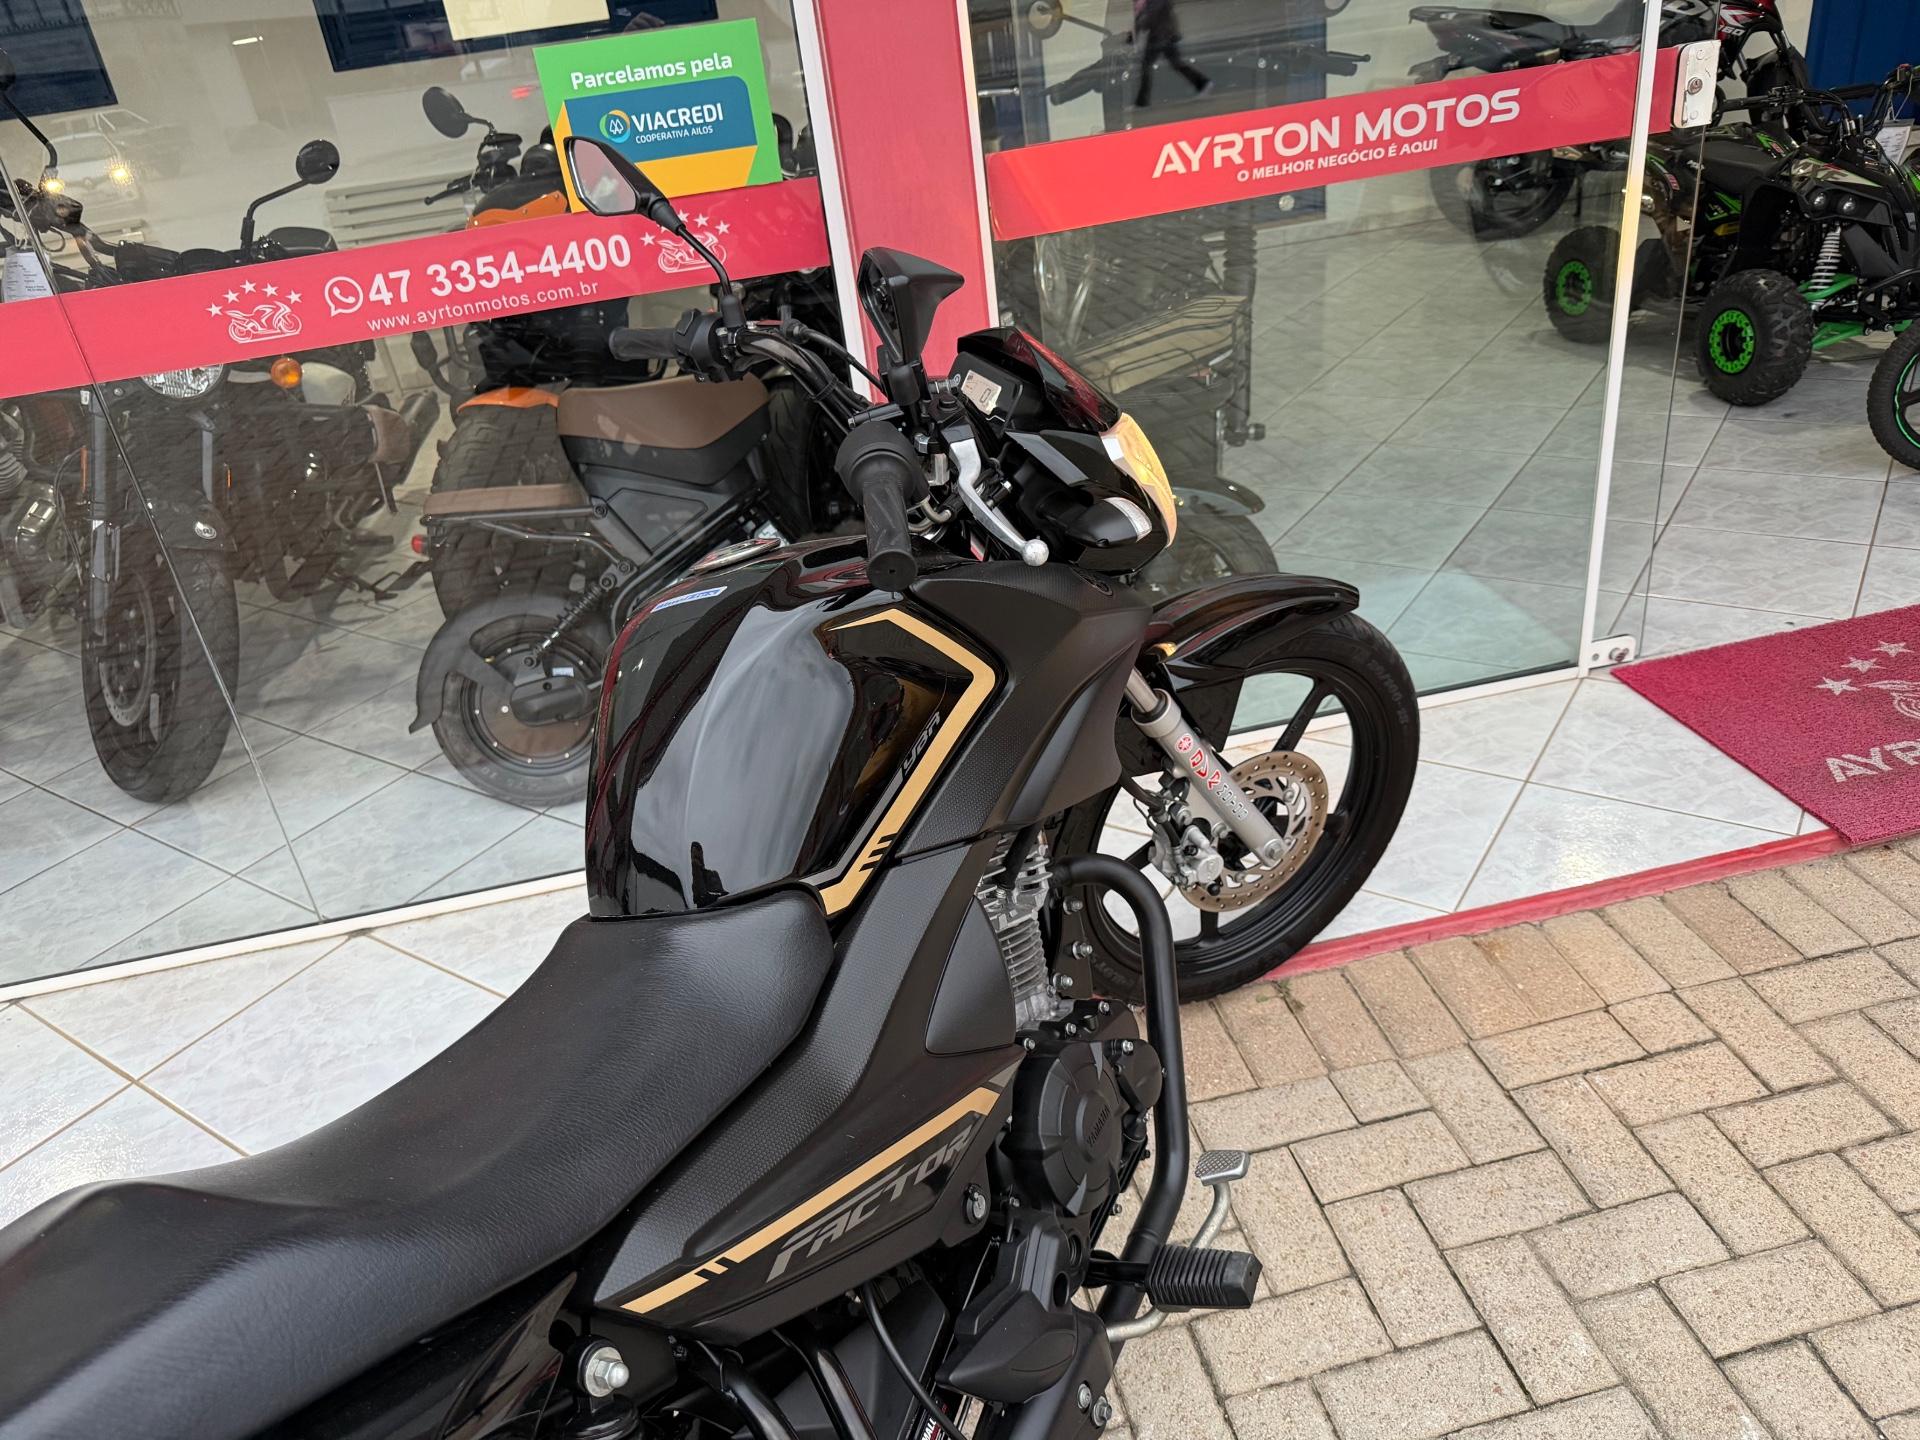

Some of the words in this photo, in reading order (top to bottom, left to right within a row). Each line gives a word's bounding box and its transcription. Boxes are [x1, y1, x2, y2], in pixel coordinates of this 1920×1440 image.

[571, 61, 687, 90] Parcelamos
[690, 52, 733, 78] pela
[631, 102, 724, 132] VIACREDI
[635, 129, 690, 144] COOPERATIVA
[691, 125, 714, 136] AILOS
[1152, 115, 1341, 178] AYRTON
[1355, 87, 1521, 145] MOTOS
[1237, 170, 1250, 182] O
[1252, 159, 1315, 180] MELHOR
[1318, 147, 1386, 170] NEGÓCIO
[1388, 141, 1399, 157] É
[1399, 138, 1439, 155] AQUI
[368, 269, 411, 306] 47
[426, 234, 632, 297] 3354-4400
[366, 280, 599, 332] www.ayrtonmotos.com.br
[766, 1123, 973, 1284] FACTOR
